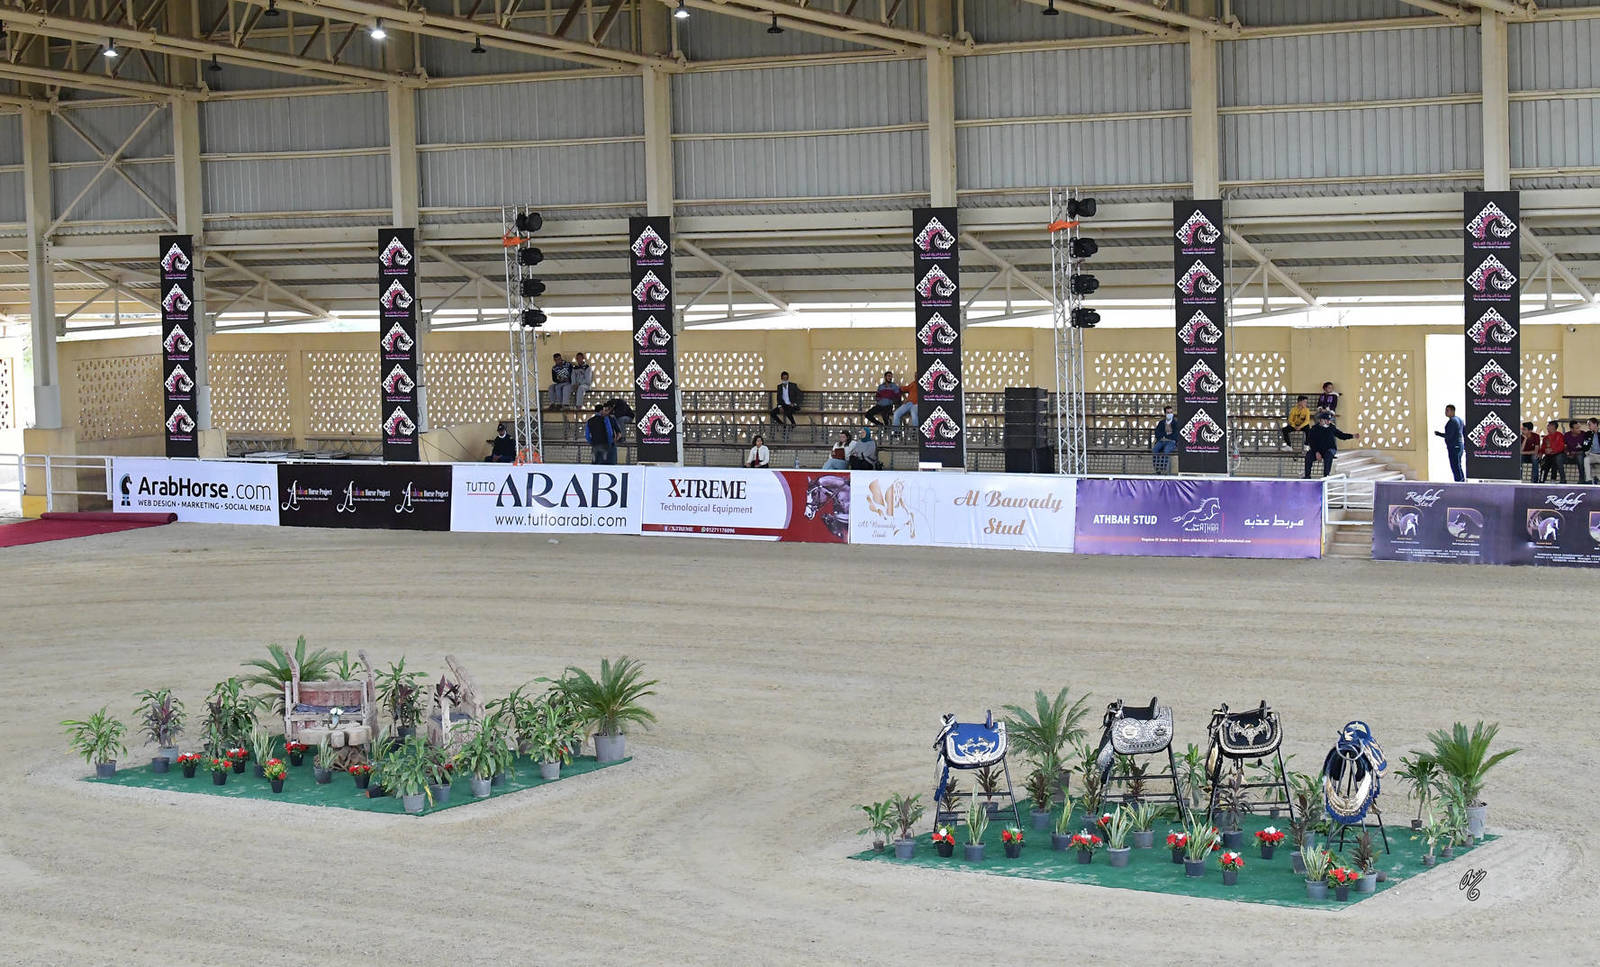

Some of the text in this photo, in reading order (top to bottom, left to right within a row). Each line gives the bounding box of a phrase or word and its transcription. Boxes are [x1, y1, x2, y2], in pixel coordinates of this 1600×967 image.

[138, 475, 272, 500] ArabHorse.com
[466, 481, 496, 492] TUTTO
[496, 472, 629, 508] ARABI
[667, 478, 747, 499] X-TREME
[138, 499, 152, 507] WEB
[181, 501, 220, 510] MARKETING
[224, 503, 248, 511] SOCIAL
[250, 504, 272, 512] MEDIA
[660, 502, 753, 514] Technological Equipment
[984, 490, 1063, 513] Bawady
[495, 513, 627, 527] www.tuttoarabi.com
[983, 517, 1026, 535] Stud
[1093, 514, 1158, 525] ATHBAH STUD
[1272, 514, 1304, 529] مربط
